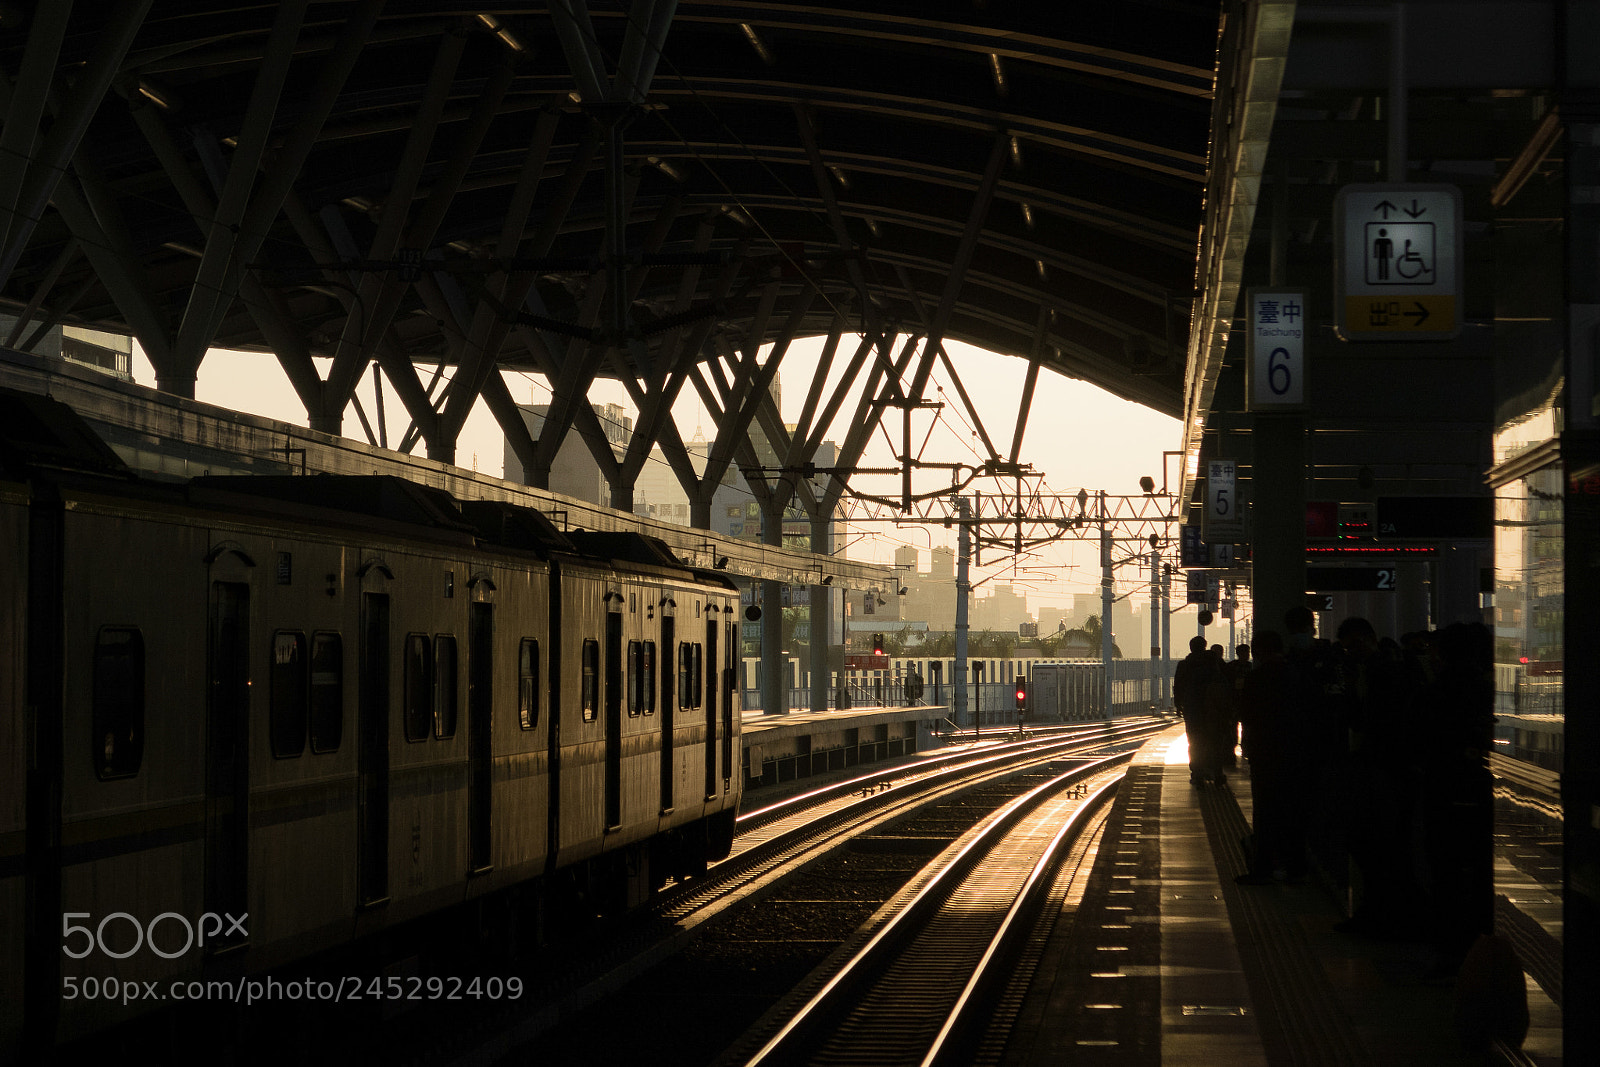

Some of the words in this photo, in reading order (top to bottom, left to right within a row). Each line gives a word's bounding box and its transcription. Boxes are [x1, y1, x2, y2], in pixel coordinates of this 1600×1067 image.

[1258, 300, 1301, 324] 臺中
[1369, 302, 1400, 327] 出口
[1257, 327, 1301, 338] Taichung
[1268, 347, 1291, 395] 6
[1215, 489, 1229, 516] 5
[1380, 522, 1397, 534] 2A
[1219, 545, 1228, 563] 4
[1193, 572, 1201, 587] 3
